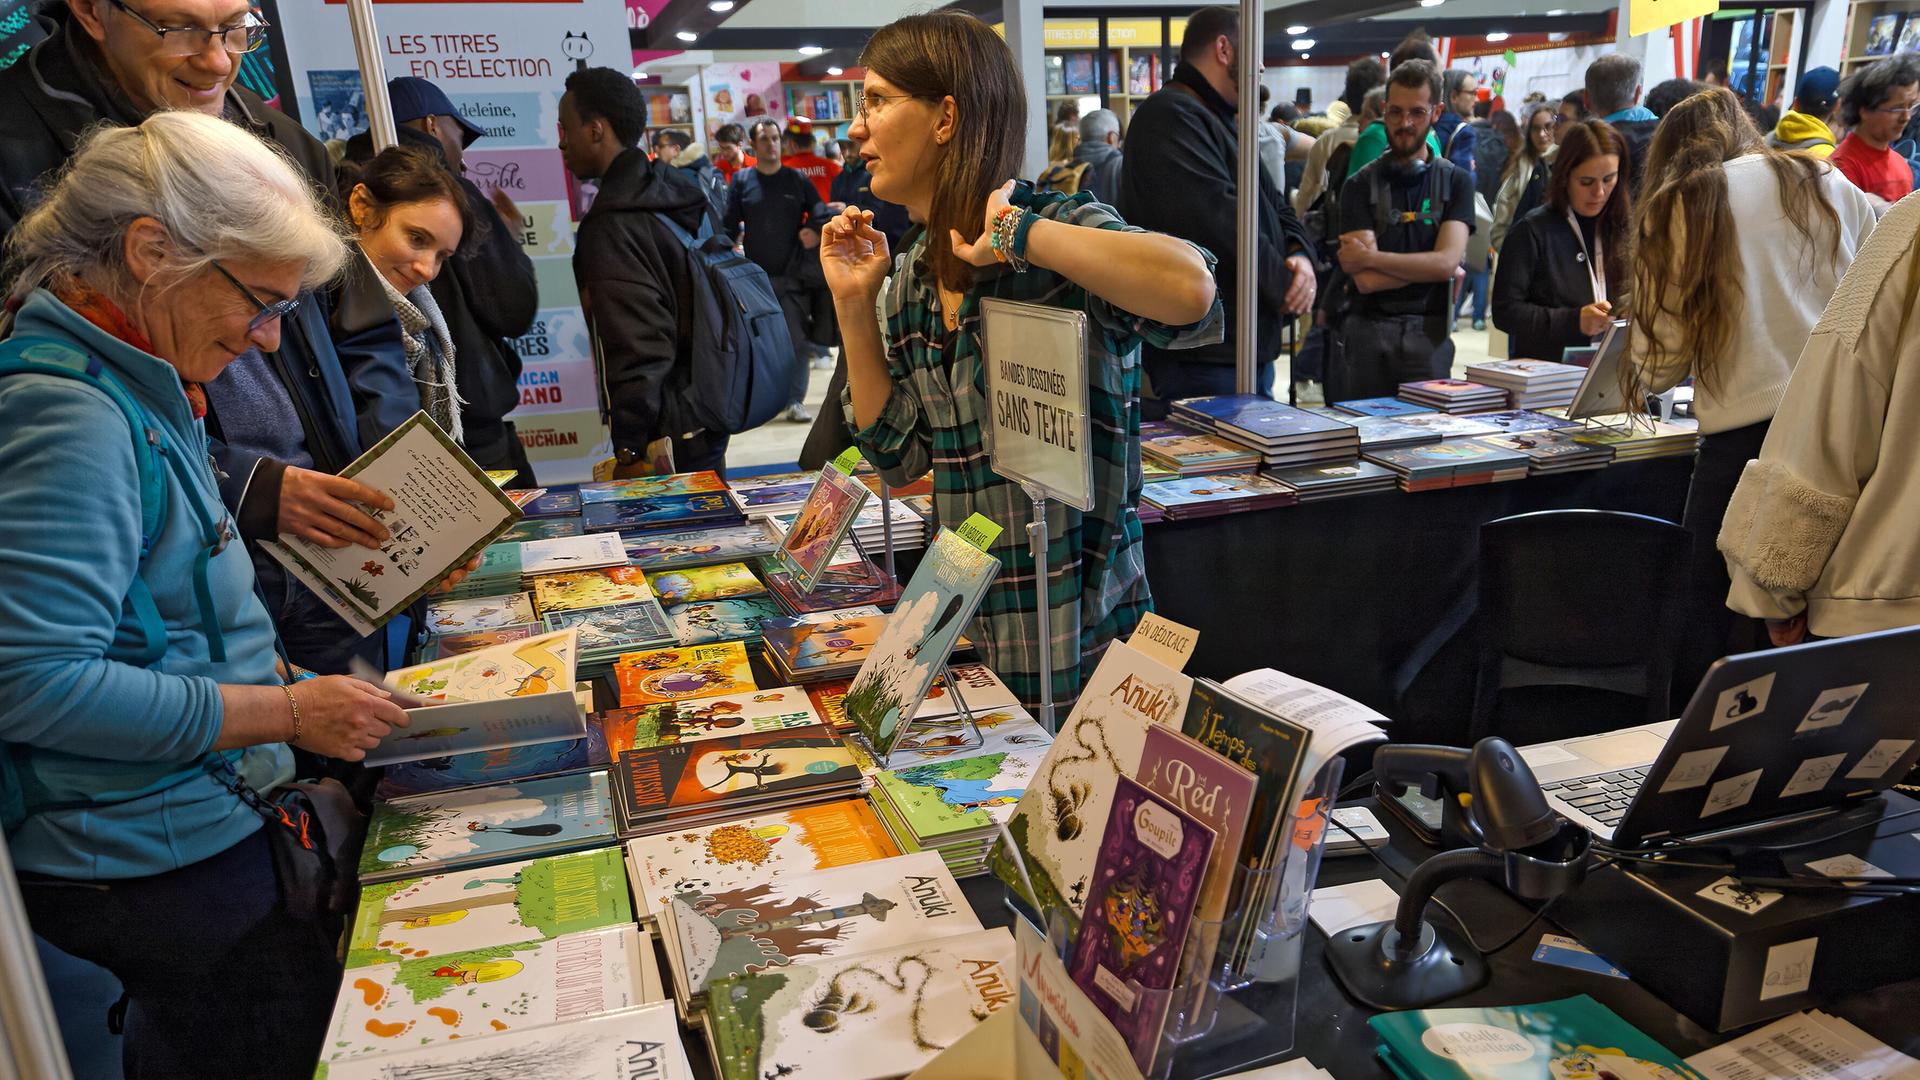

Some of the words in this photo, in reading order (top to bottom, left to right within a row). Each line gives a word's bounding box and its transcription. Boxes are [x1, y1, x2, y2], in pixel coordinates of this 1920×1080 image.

[386, 34, 427, 54] LES
[430, 34, 500, 54] TITRES
[410, 60, 440, 79] EN
[443, 55, 552, 79] SÉLECTION
[459, 102, 516, 118] deleine,
[484, 125, 516, 138] ante
[517, 371, 559, 386] ICAN
[519, 386, 563, 405] ANO
[1000, 359, 1026, 387] BANDES
[1026, 363, 1067, 398] DESSINÉES
[996, 390, 1031, 438] SANS
[1033, 401, 1076, 453] TEXTE
[514, 432, 578, 449] OUCHIAN
[1137, 619, 1150, 636] EN
[1149, 622, 1190, 655] DÉDICACE
[1110, 673, 1173, 722] Anuki
[751, 714, 782, 732] DEU
[1166, 759, 1223, 817] Red
[904, 874, 958, 919] Anuki
[962, 957, 1018, 1014] Anuk
[556, 987, 605, 1021] POUSSE
[626, 1039, 665, 1080] Anu
